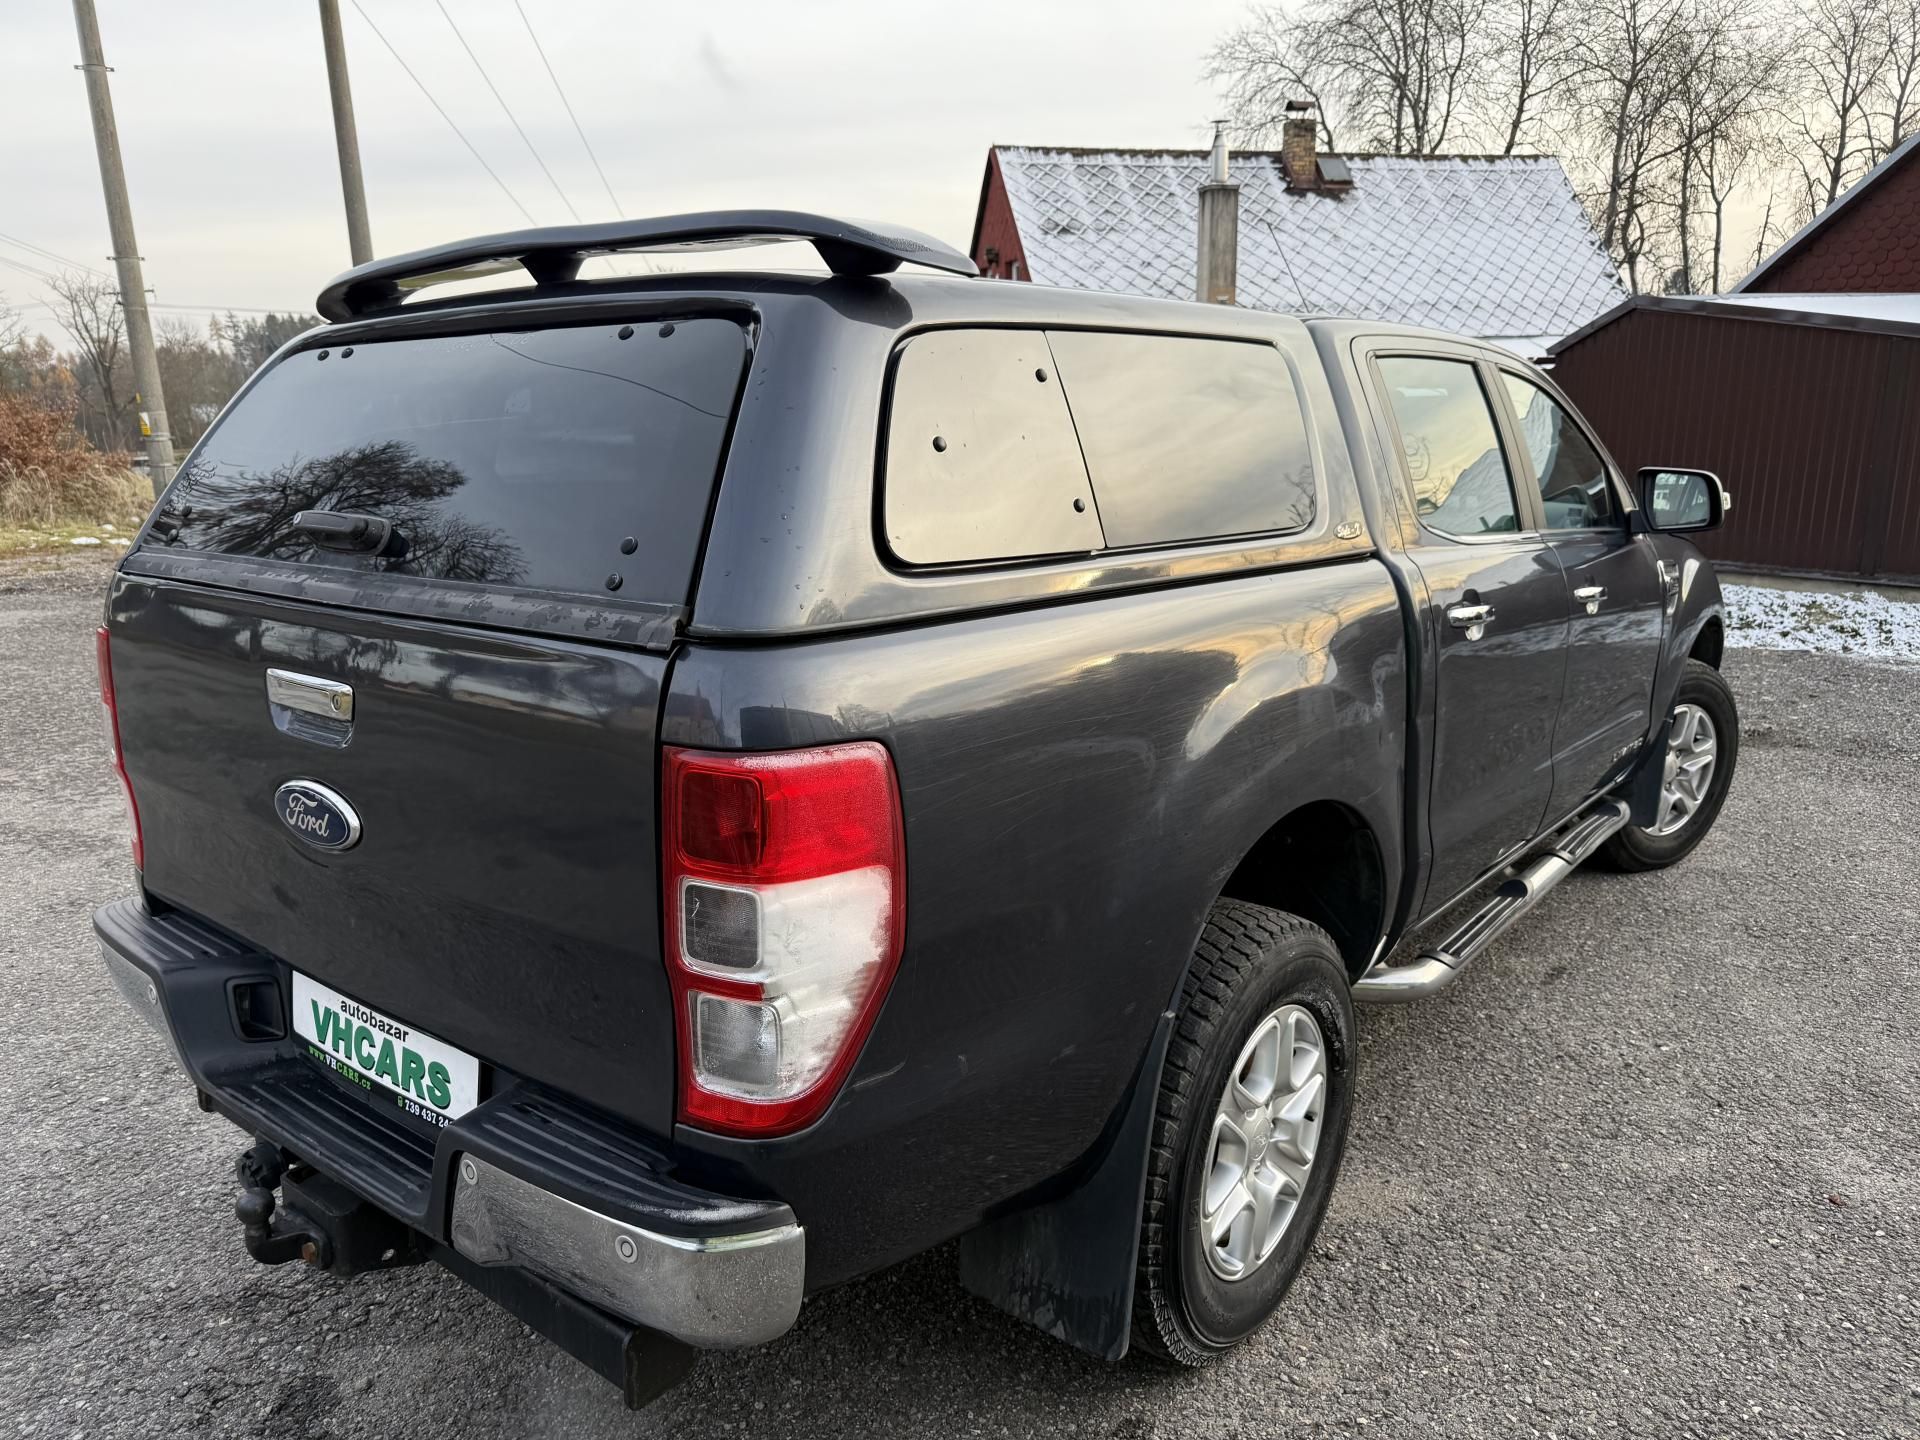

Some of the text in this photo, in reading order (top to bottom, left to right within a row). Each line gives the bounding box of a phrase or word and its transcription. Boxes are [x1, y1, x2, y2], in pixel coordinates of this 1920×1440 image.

[286, 793, 330, 837] Ford
[340, 1000, 409, 1043] autobazar
[308, 1045, 371, 1090] www.VHCARS.cz
[311, 998, 451, 1110] VHCARS
[405, 1099, 453, 1128] 739 437 24
